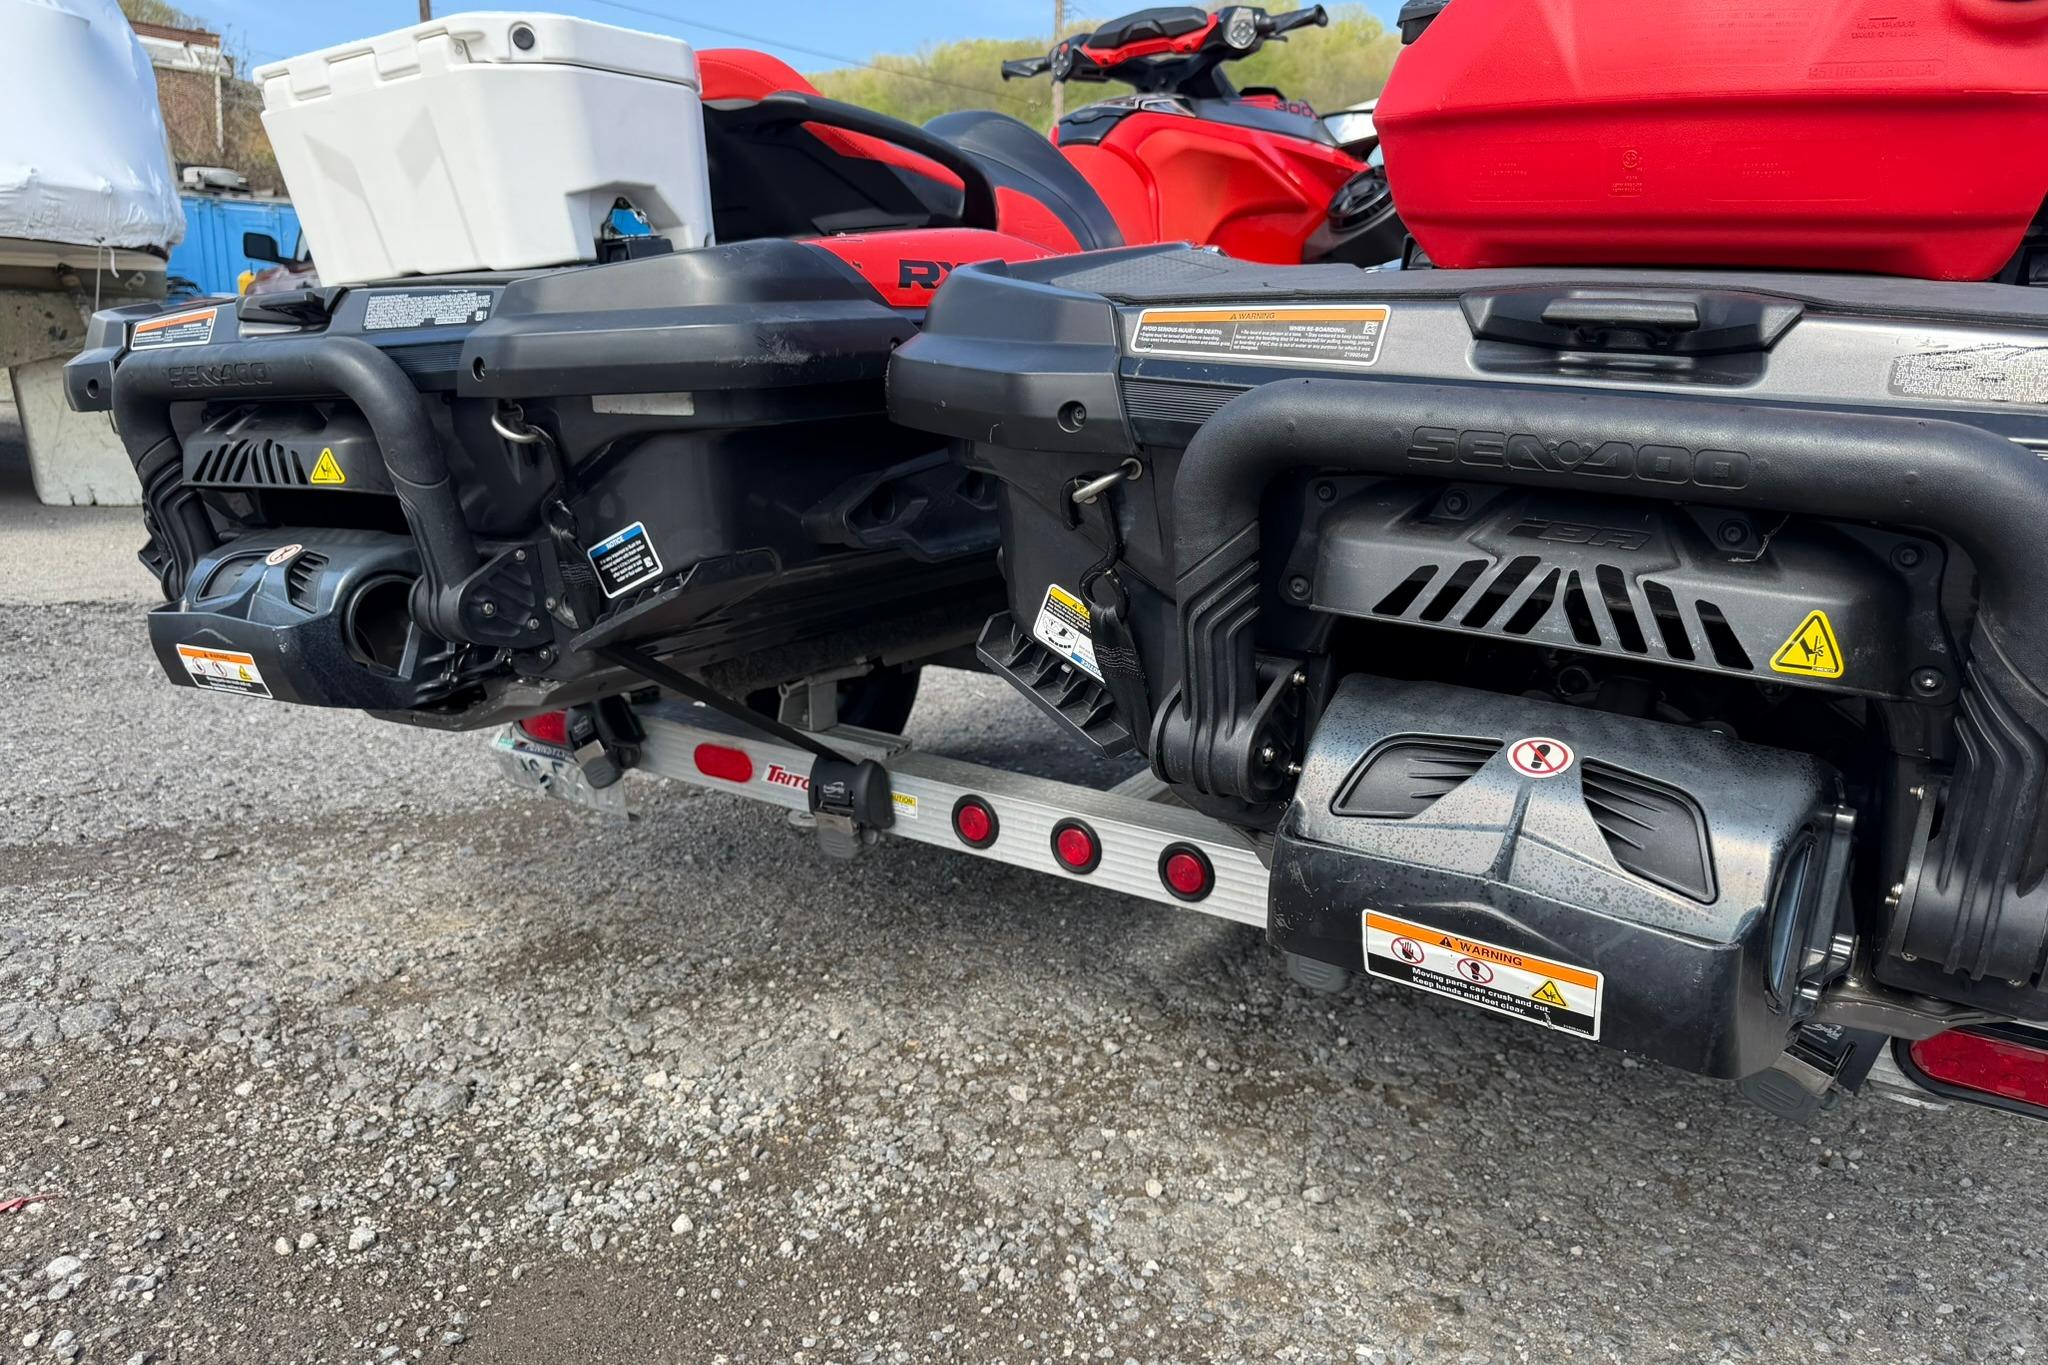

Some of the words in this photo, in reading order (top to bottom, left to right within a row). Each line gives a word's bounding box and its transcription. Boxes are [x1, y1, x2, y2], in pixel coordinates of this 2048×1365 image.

[1239, 312, 1276, 320] WARNING
[605, 535, 625, 550] NOTICE
[768, 764, 810, 791] TRITO
[1459, 941, 1523, 967] WARNING
[1412, 967, 1444, 983] Moving
[1445, 976, 1468, 990] parts
[1469, 984, 1486, 994] can
[1488, 985, 1513, 1002] crush
[1515, 995, 1532, 1008] and
[1533, 1001, 1550, 1013] cut.
[1412, 976, 1434, 989] Keep
[1435, 981, 1462, 996] hands
[1463, 989, 1480, 1001] and
[1481, 994, 1499, 1006] feet
[1500, 1001, 1526, 1016] clear.
